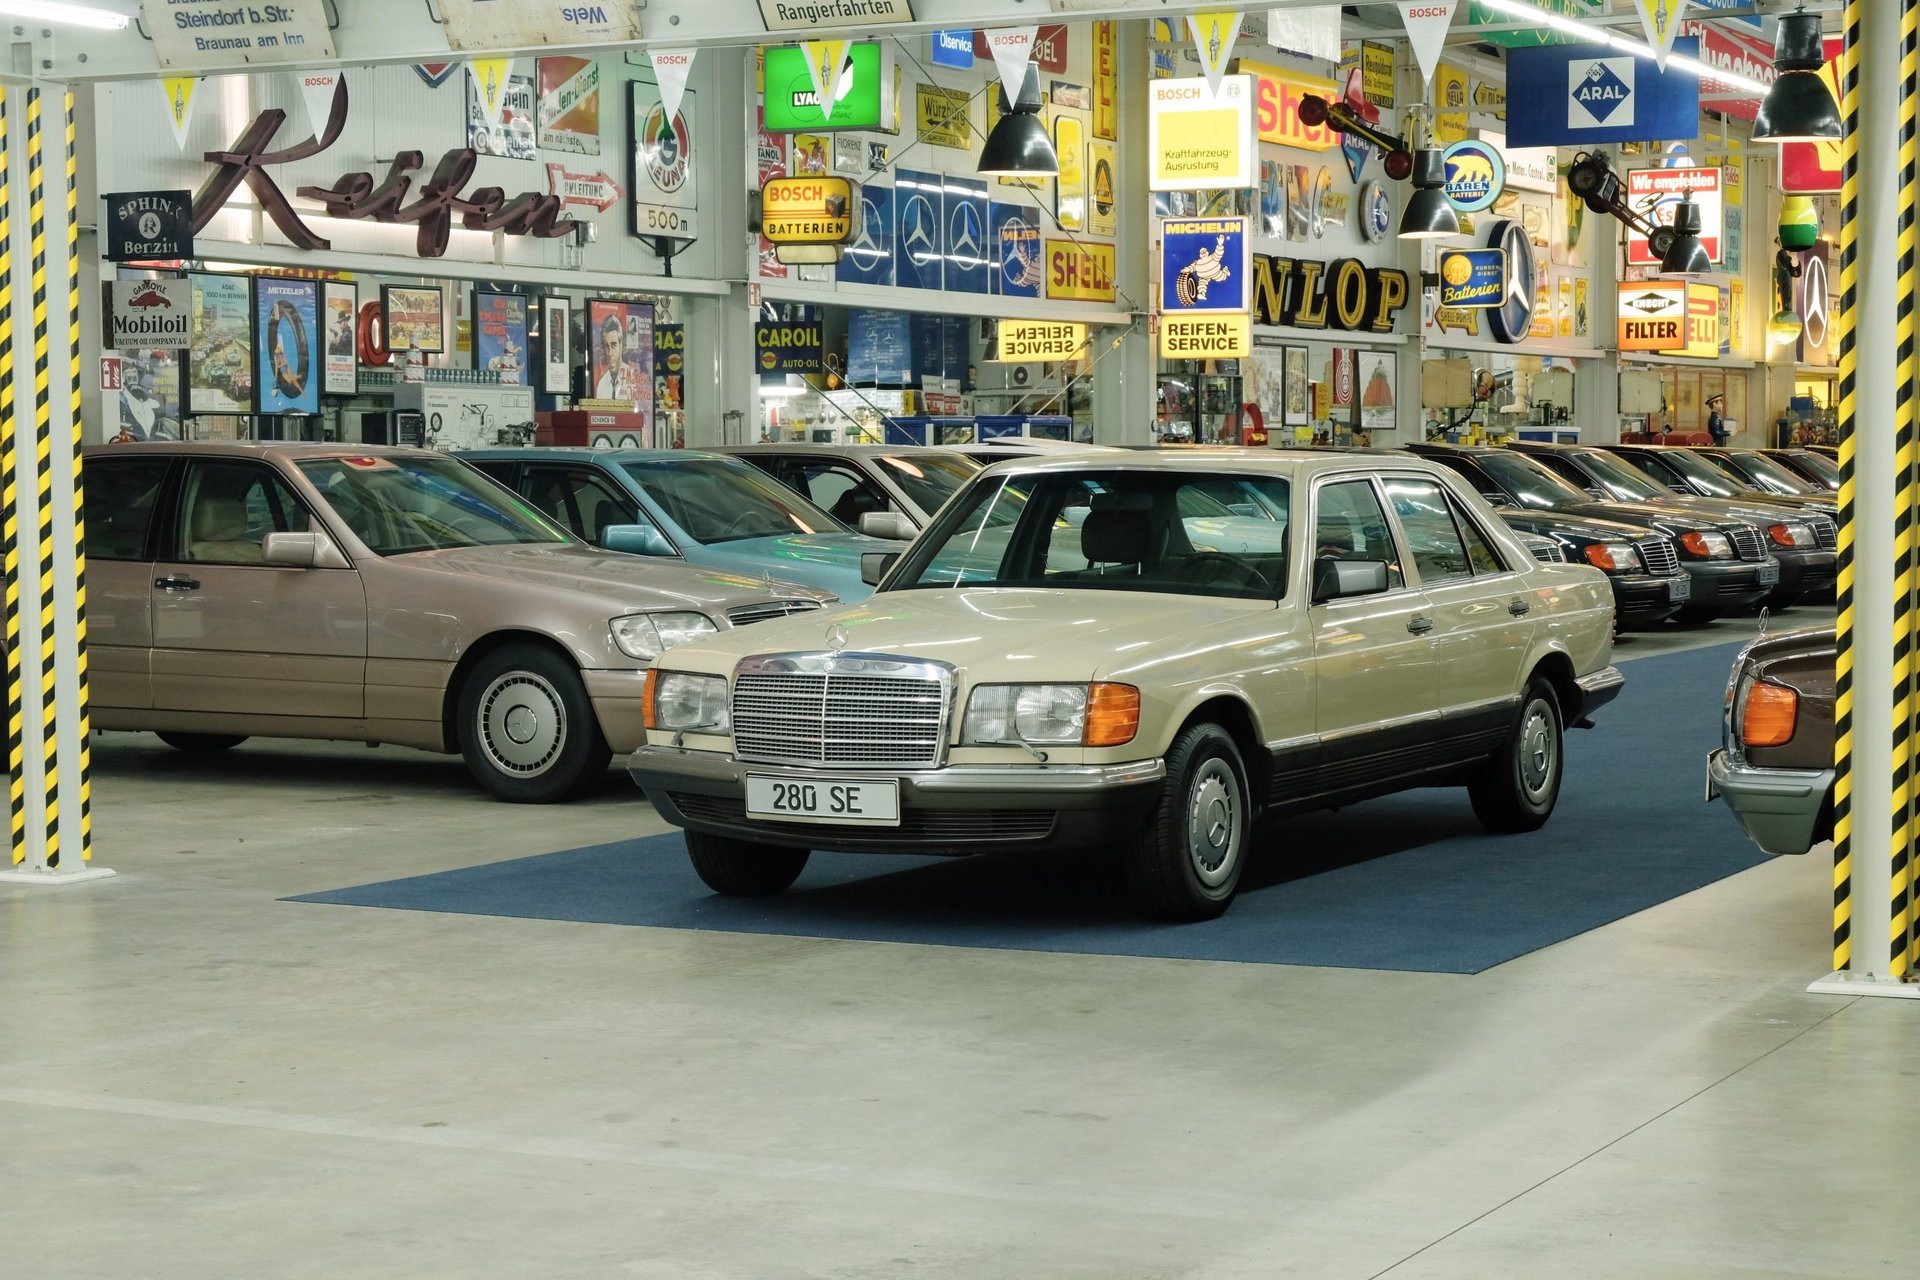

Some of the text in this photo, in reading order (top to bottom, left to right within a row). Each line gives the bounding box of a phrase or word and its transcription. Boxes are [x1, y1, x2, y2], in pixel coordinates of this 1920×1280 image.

[174, 7, 246, 29] Steindorf
[562, 6, 608, 25] Wels
[777, 0, 895, 23] Rangierfahrten
[1409, 7, 1447, 19] BOSCH
[195, 32, 305, 51] Braunau am Inn
[940, 30, 973, 52] Ölservice
[994, 34, 1028, 46] BOSCH
[656, 55, 688, 65] BOSCH
[304, 77, 334, 87] BOSCH
[1100, 20, 1112, 136] HELL
[1157, 88, 1201, 100] BOSCH
[1365, 93, 1394, 108] DUNLOP
[1579, 86, 1624, 102] ARAL
[837, 137, 862, 151] FLORENZ
[758, 148, 780, 161] TANOL
[1165, 148, 1233, 161] Kraftfahrzeug-
[649, 158, 688, 188] LEUNA
[1632, 172, 1716, 191] Wir empfehlen
[769, 186, 823, 202] BOSCH
[1450, 190, 1486, 199] BATTERIE
[647, 209, 688, 232] 500 m
[769, 222, 844, 235] BATTERIEN
[1165, 221, 1241, 235] MICHELIN
[124, 237, 179, 255] Benzin
[1053, 250, 1111, 290] SHELL
[267, 286, 305, 296] METZELER
[1252, 253, 1409, 333] NLOP
[1442, 281, 1502, 304] Batterien
[1632, 298, 1671, 309] KNECHT
[113, 314, 188, 334] Mobiloil
[1168, 323, 1238, 336] REIFEN-
[1625, 321, 1678, 339] FILTER
[1689, 318, 1716, 344] ELLI
[114, 338, 138, 346] VACUUM
[148, 337, 177, 346] COMPANY
[757, 327, 821, 348] CAROIL
[1167, 337, 1238, 351] SERVICE
[782, 359, 819, 369] AUTO-OIL
[772, 783, 863, 813] 280 SE
